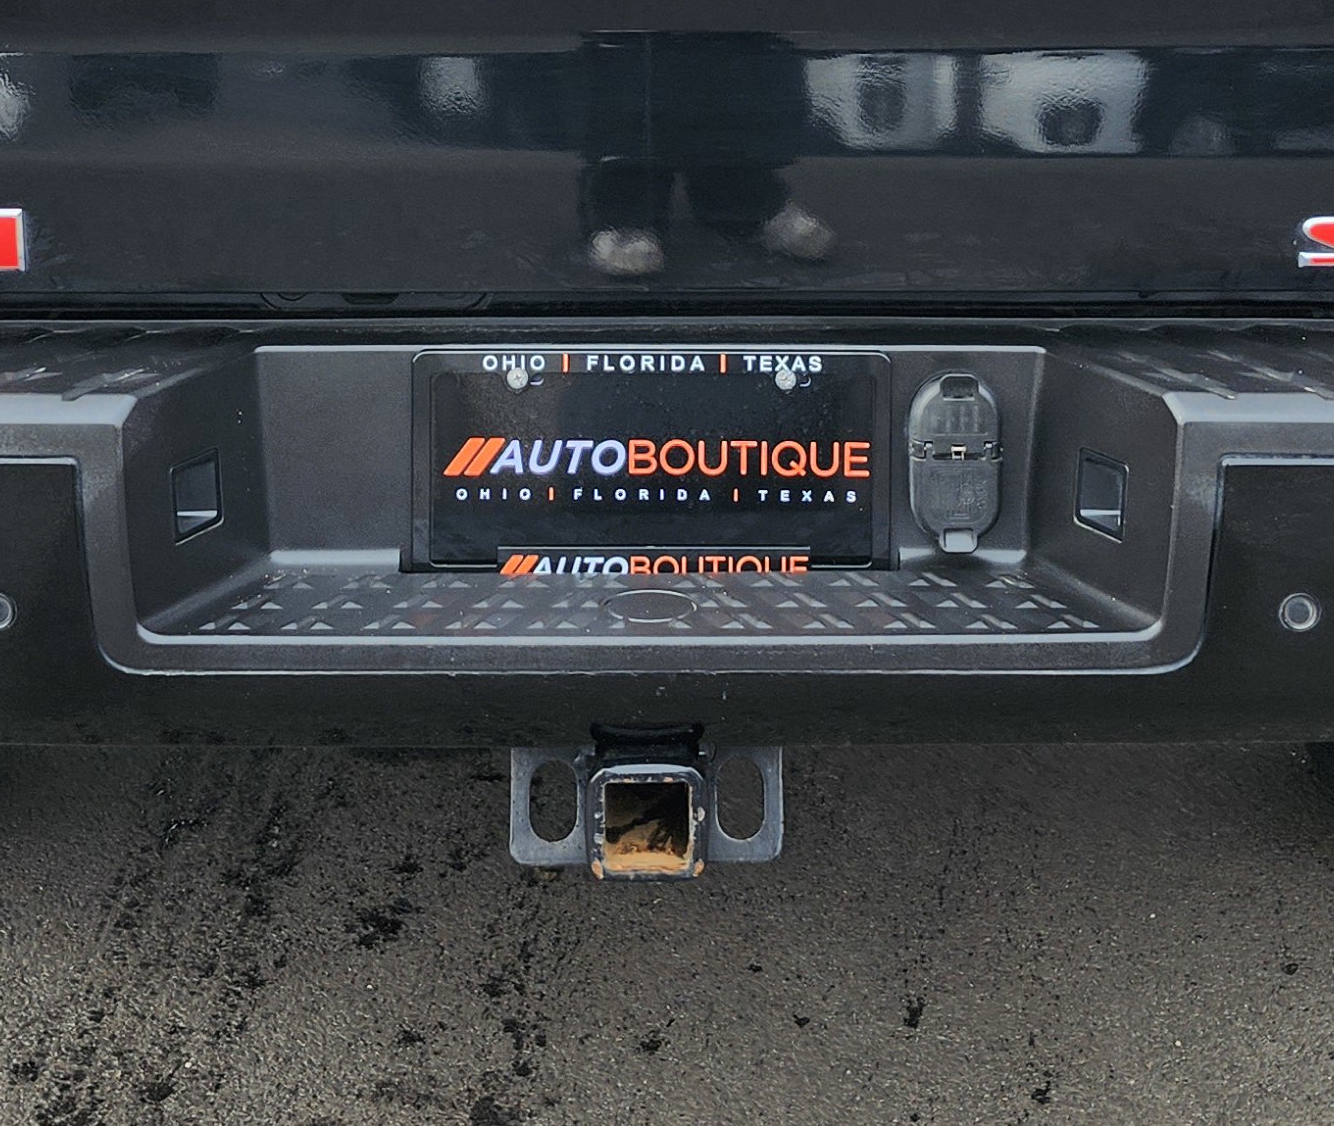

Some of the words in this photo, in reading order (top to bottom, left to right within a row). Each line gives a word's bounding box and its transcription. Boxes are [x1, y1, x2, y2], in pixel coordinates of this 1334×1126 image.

[482, 355, 546, 372] OHIO
[586, 355, 705, 372] FLORIDA
[744, 355, 823, 373] TEXAS
[490, 437, 871, 478] AUTOBOUTIQUE
[455, 487, 532, 501] OHIO
[573, 487, 711, 501] FLORIDA
[757, 488, 857, 503] TEXAS
